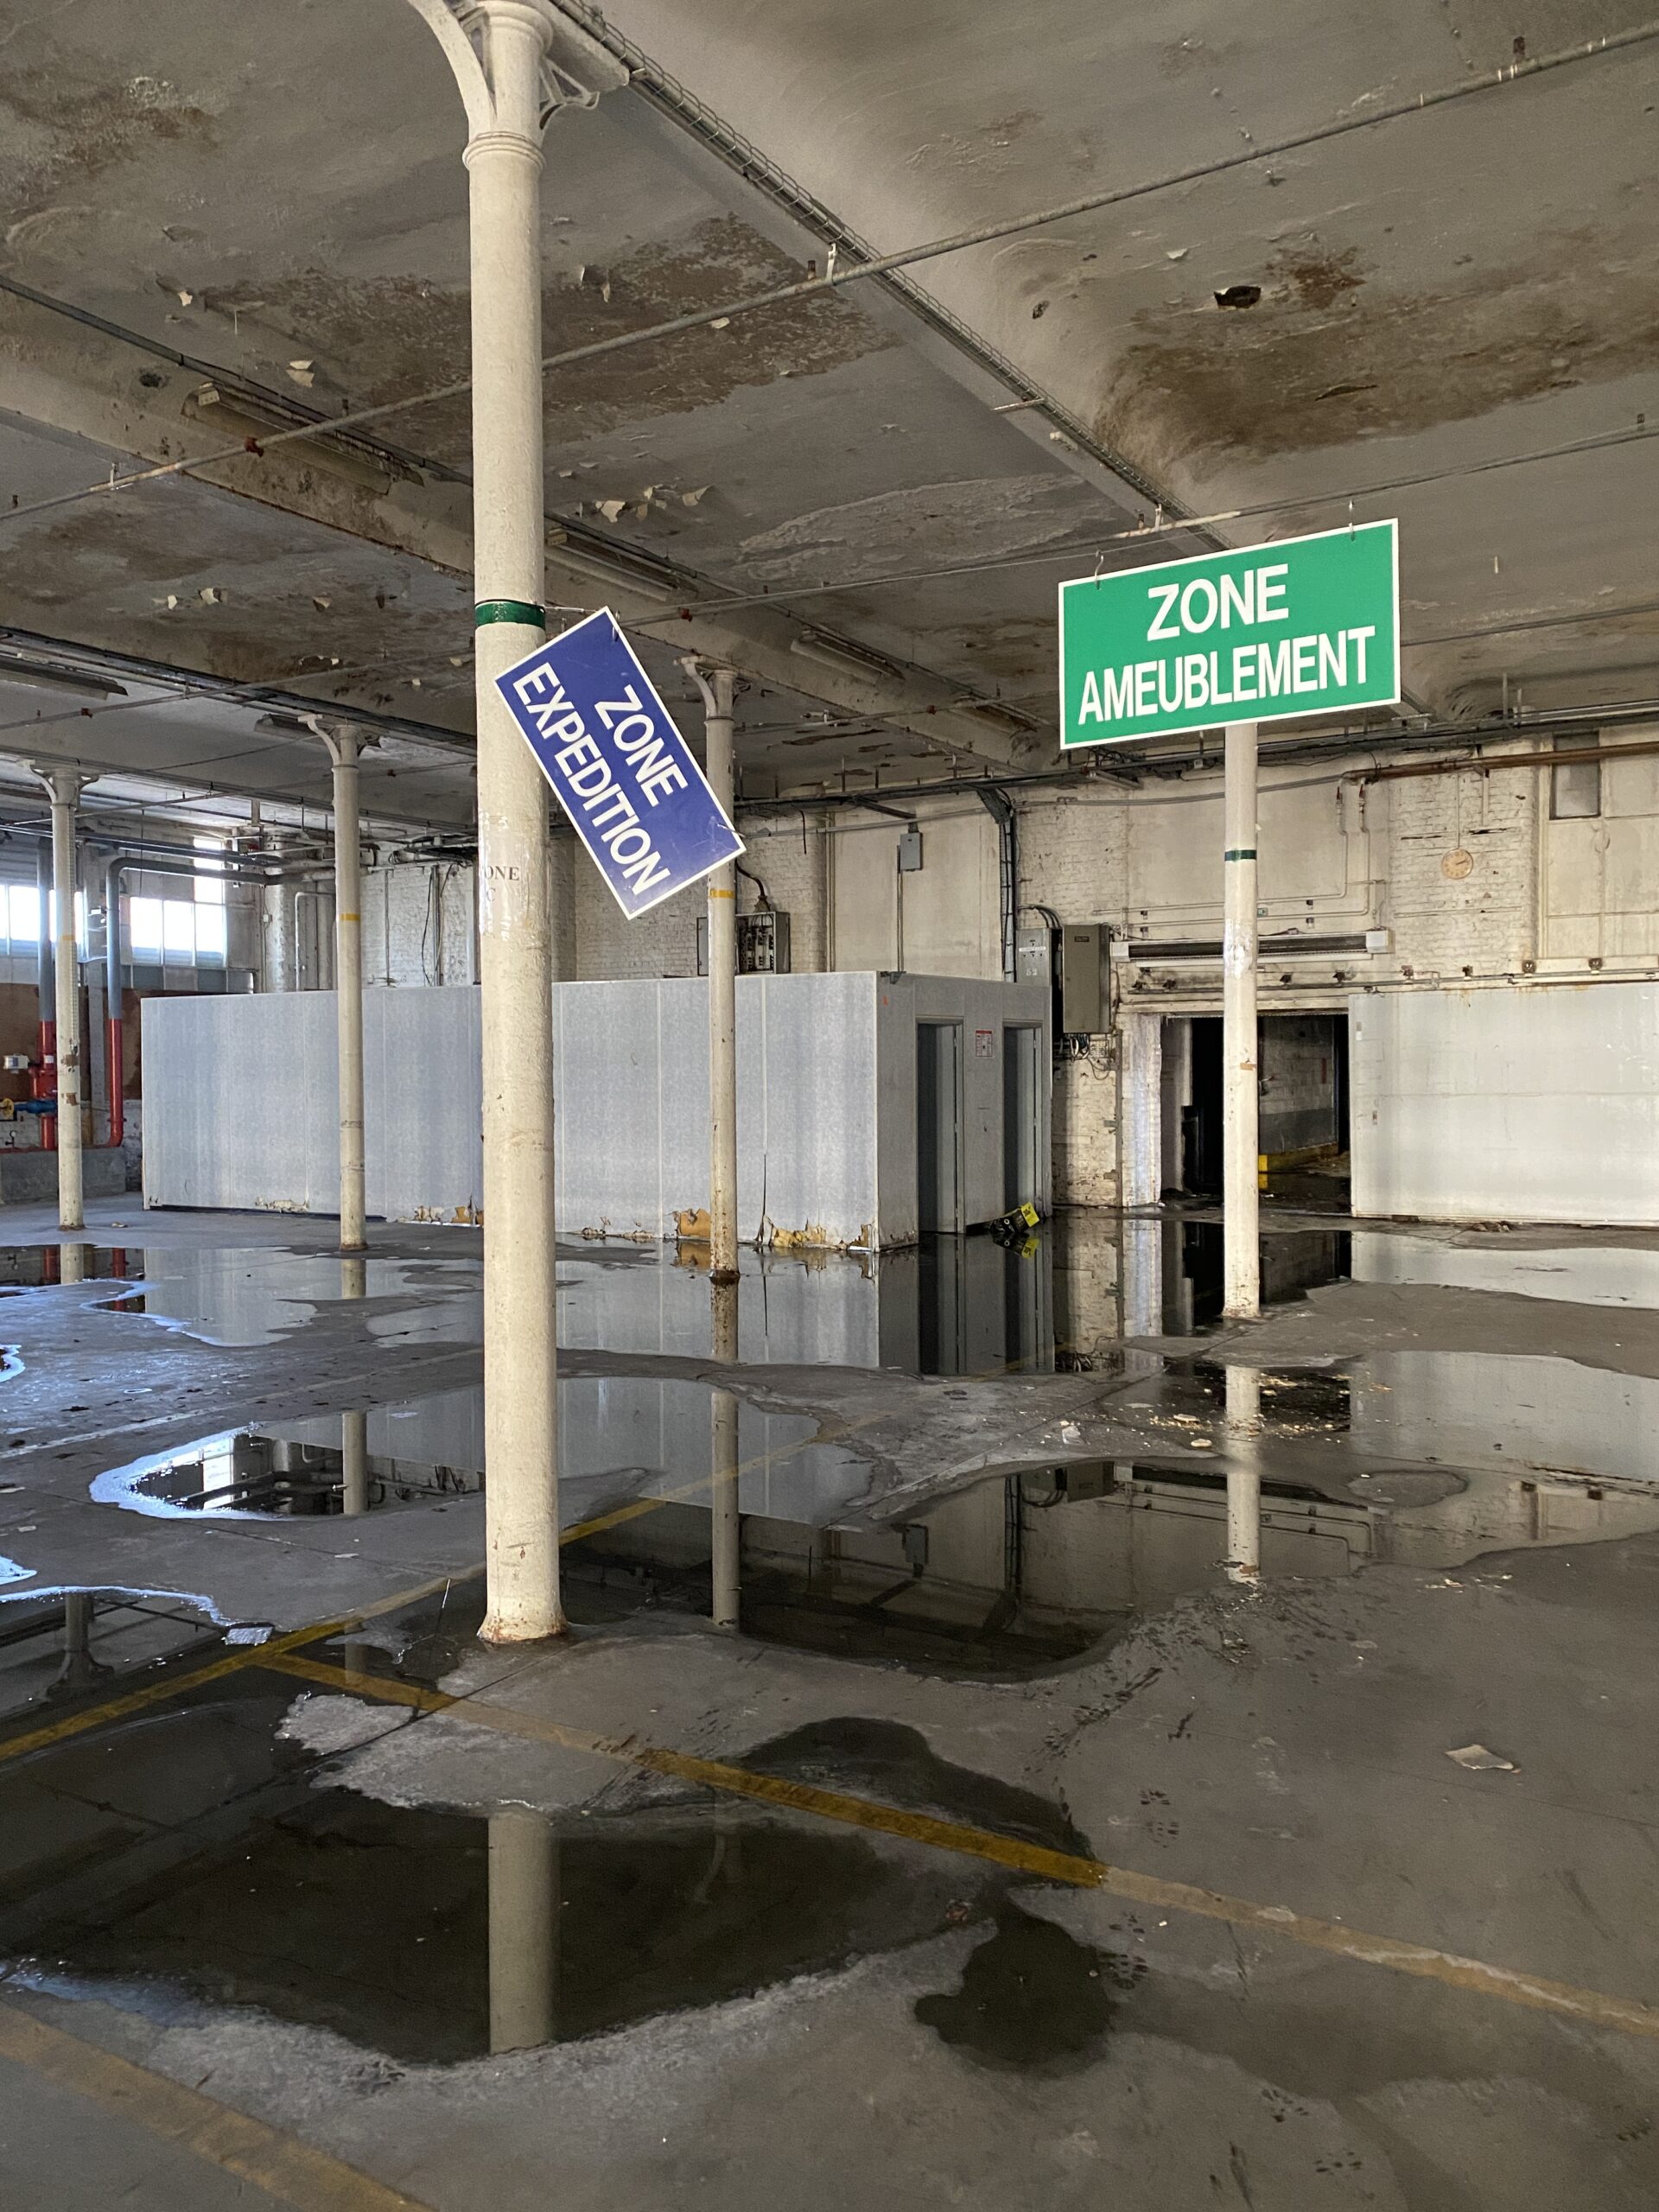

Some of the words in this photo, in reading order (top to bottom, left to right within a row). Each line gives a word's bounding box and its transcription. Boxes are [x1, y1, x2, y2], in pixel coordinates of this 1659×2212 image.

[1147, 563, 1289, 641] ZONE
[1078, 625, 1376, 724] AMEUBLEMENT
[512, 662, 671, 895] EXPEDITION
[594, 684, 688, 807] ZONE
[481, 865, 520, 881] ONE
